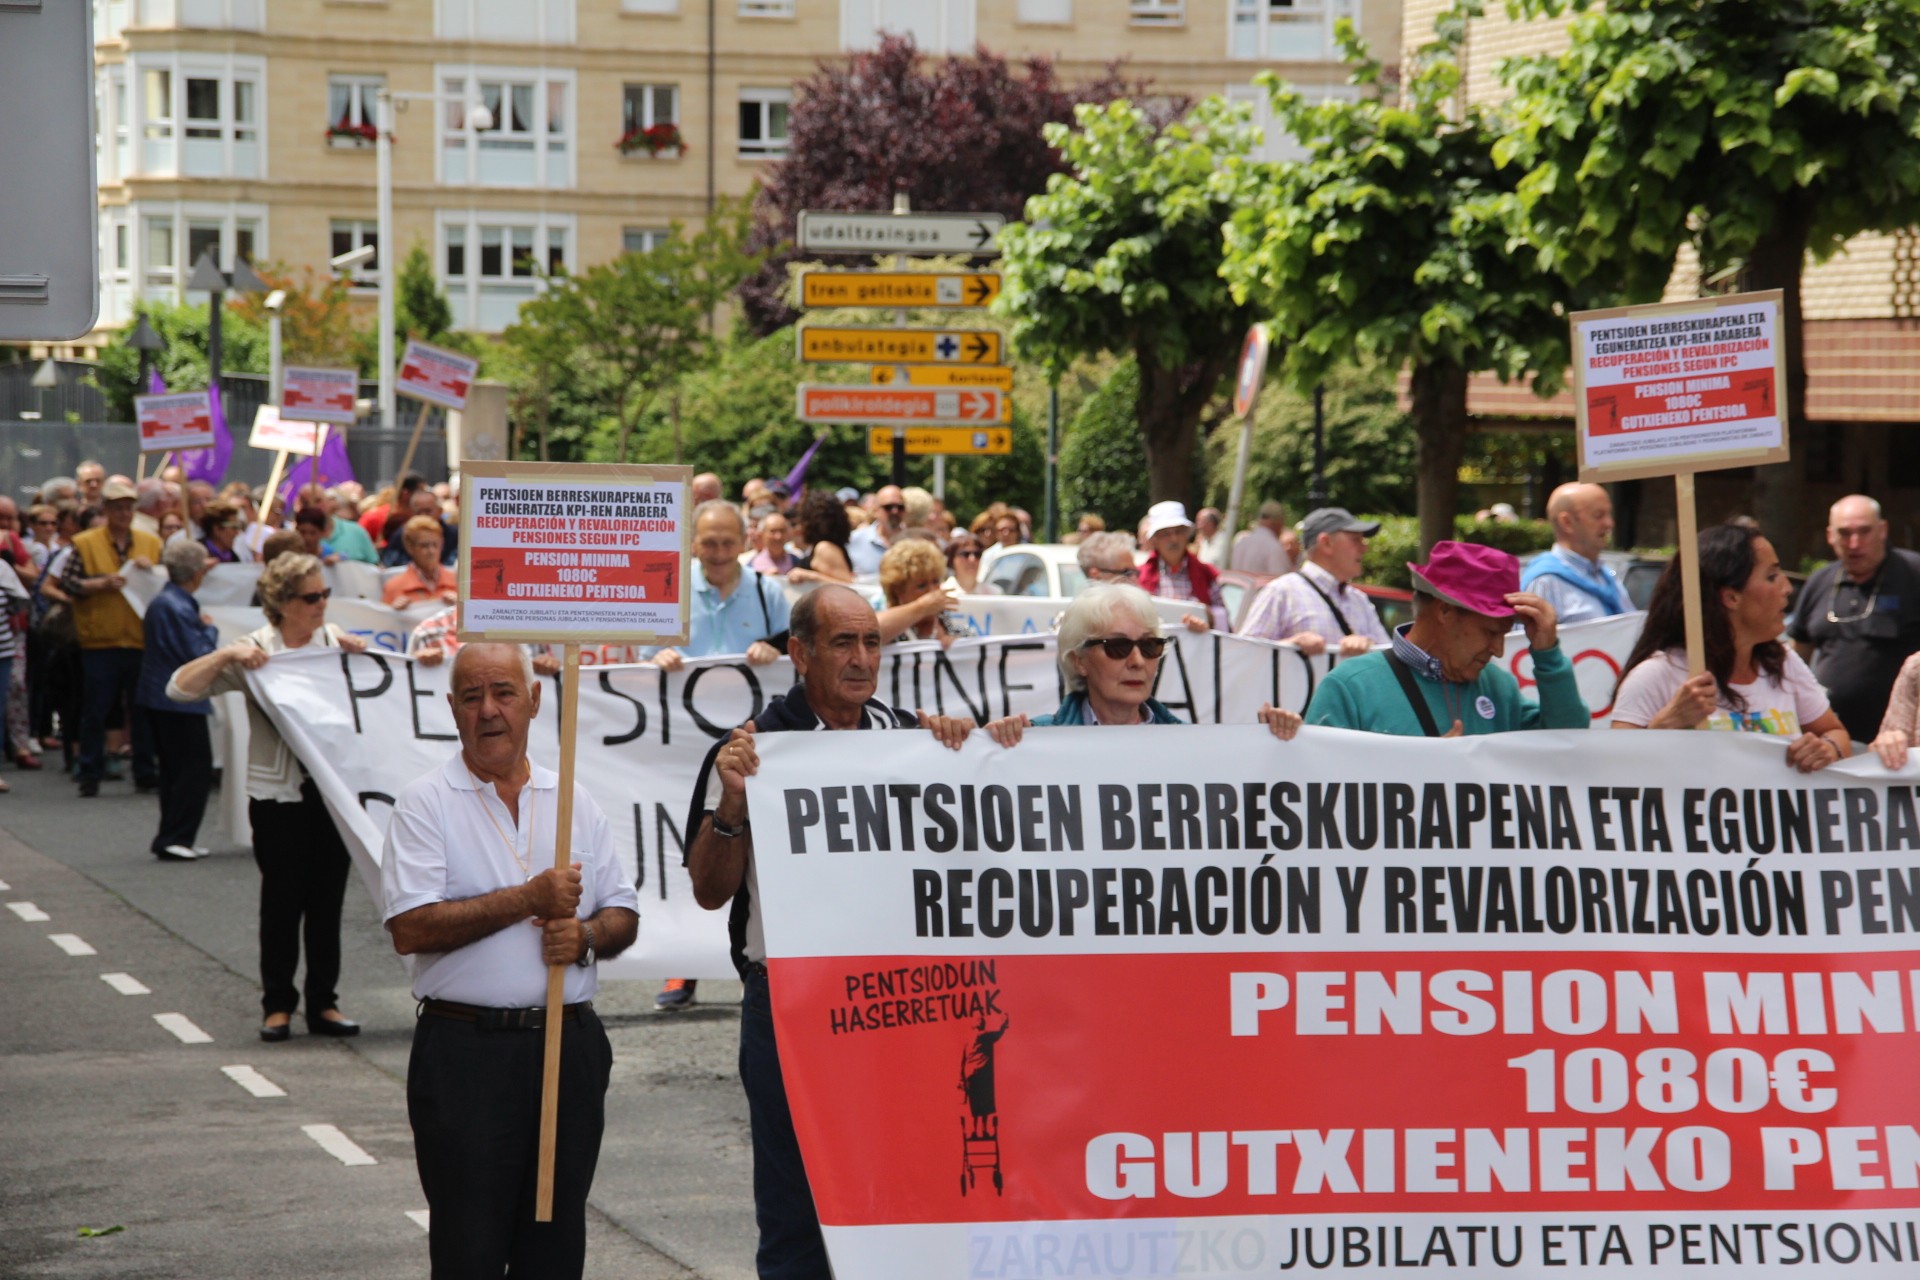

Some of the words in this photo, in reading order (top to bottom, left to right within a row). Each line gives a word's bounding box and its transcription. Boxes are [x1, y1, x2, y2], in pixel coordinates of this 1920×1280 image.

[809, 225, 940, 242] udaltzaingoa
[810, 284, 848, 296] tren
[858, 283, 932, 299] geltokia
[1590, 325, 1648, 341] PENTSIOEN
[1650, 314, 1746, 336] BERRESKURAPENA
[1748, 312, 1766, 324] ETA
[810, 339, 927, 355] anbulategia
[1596, 336, 1667, 355] EGUNERATZEA
[1669, 332, 1711, 346] KPI-REN
[1713, 326, 1762, 342] ARABERA
[1589, 347, 1670, 369] RECUPERACIÓN
[1672, 348, 1679, 359] Y
[1681, 338, 1770, 359] REVALORIZACIÓN
[1622, 361, 1681, 378] PENSIONES
[1683, 358, 1717, 372] SEGUN
[1720, 355, 1738, 368] IPC
[1634, 380, 1685, 399] PENSION
[1685, 375, 1731, 394] MINIMA
[809, 394, 930, 415] polikiroldegia
[1620, 410, 1691, 430] GUTXIENEKO
[1692, 403, 1748, 422] PENTSIOA
[480, 488, 544, 502] PENTSIOEN
[546, 489, 651, 504] BERRESKURAPENA
[653, 492, 673, 504] ETA
[485, 502, 564, 516] EGUNERATZEA
[566, 504, 612, 517] KPI-REN
[615, 505, 668, 518] ARABERA
[477, 515, 566, 530] RECUPERACIÓN
[568, 518, 577, 530] Y
[579, 517, 675, 532] REVALORIZACIÓN
[512, 531, 577, 544] PENSIONES
[579, 532, 618, 545] SEGUN
[620, 533, 640, 545] IPC
[525, 551, 580, 566] PENSION
[581, 553, 630, 568] MINIMA
[507, 583, 583, 598] GUTXIENEKO
[586, 585, 646, 599] PENTSIOA
[783, 782, 1087, 855] PENTSIOEN
[1098, 781, 1582, 851] BERRESKURAPENA
[1588, 786, 1672, 852] ETA
[1683, 785, 1920, 855] EGUNERA
[912, 854, 1321, 938] RECUPERACIÓN
[1336, 866, 1369, 934] Y
[1384, 858, 1808, 937] REVALORIZACIÓN
[1820, 866, 1920, 936] PEN
[845, 959, 997, 1002] PENTSIODUN
[829, 989, 1003, 1035] HASERRETUAK
[1229, 968, 1680, 1037] PENSION
[1507, 1047, 1838, 1115] 1080€
[1085, 1125, 1732, 1201] GUTXIENEKO
[969, 1228, 1267, 1279] ZARAUTZKO
[1280, 1225, 1523, 1271] JUBILATU
[1541, 1224, 1633, 1267] ETA
[1649, 1221, 1920, 1267] PENTSIONI
